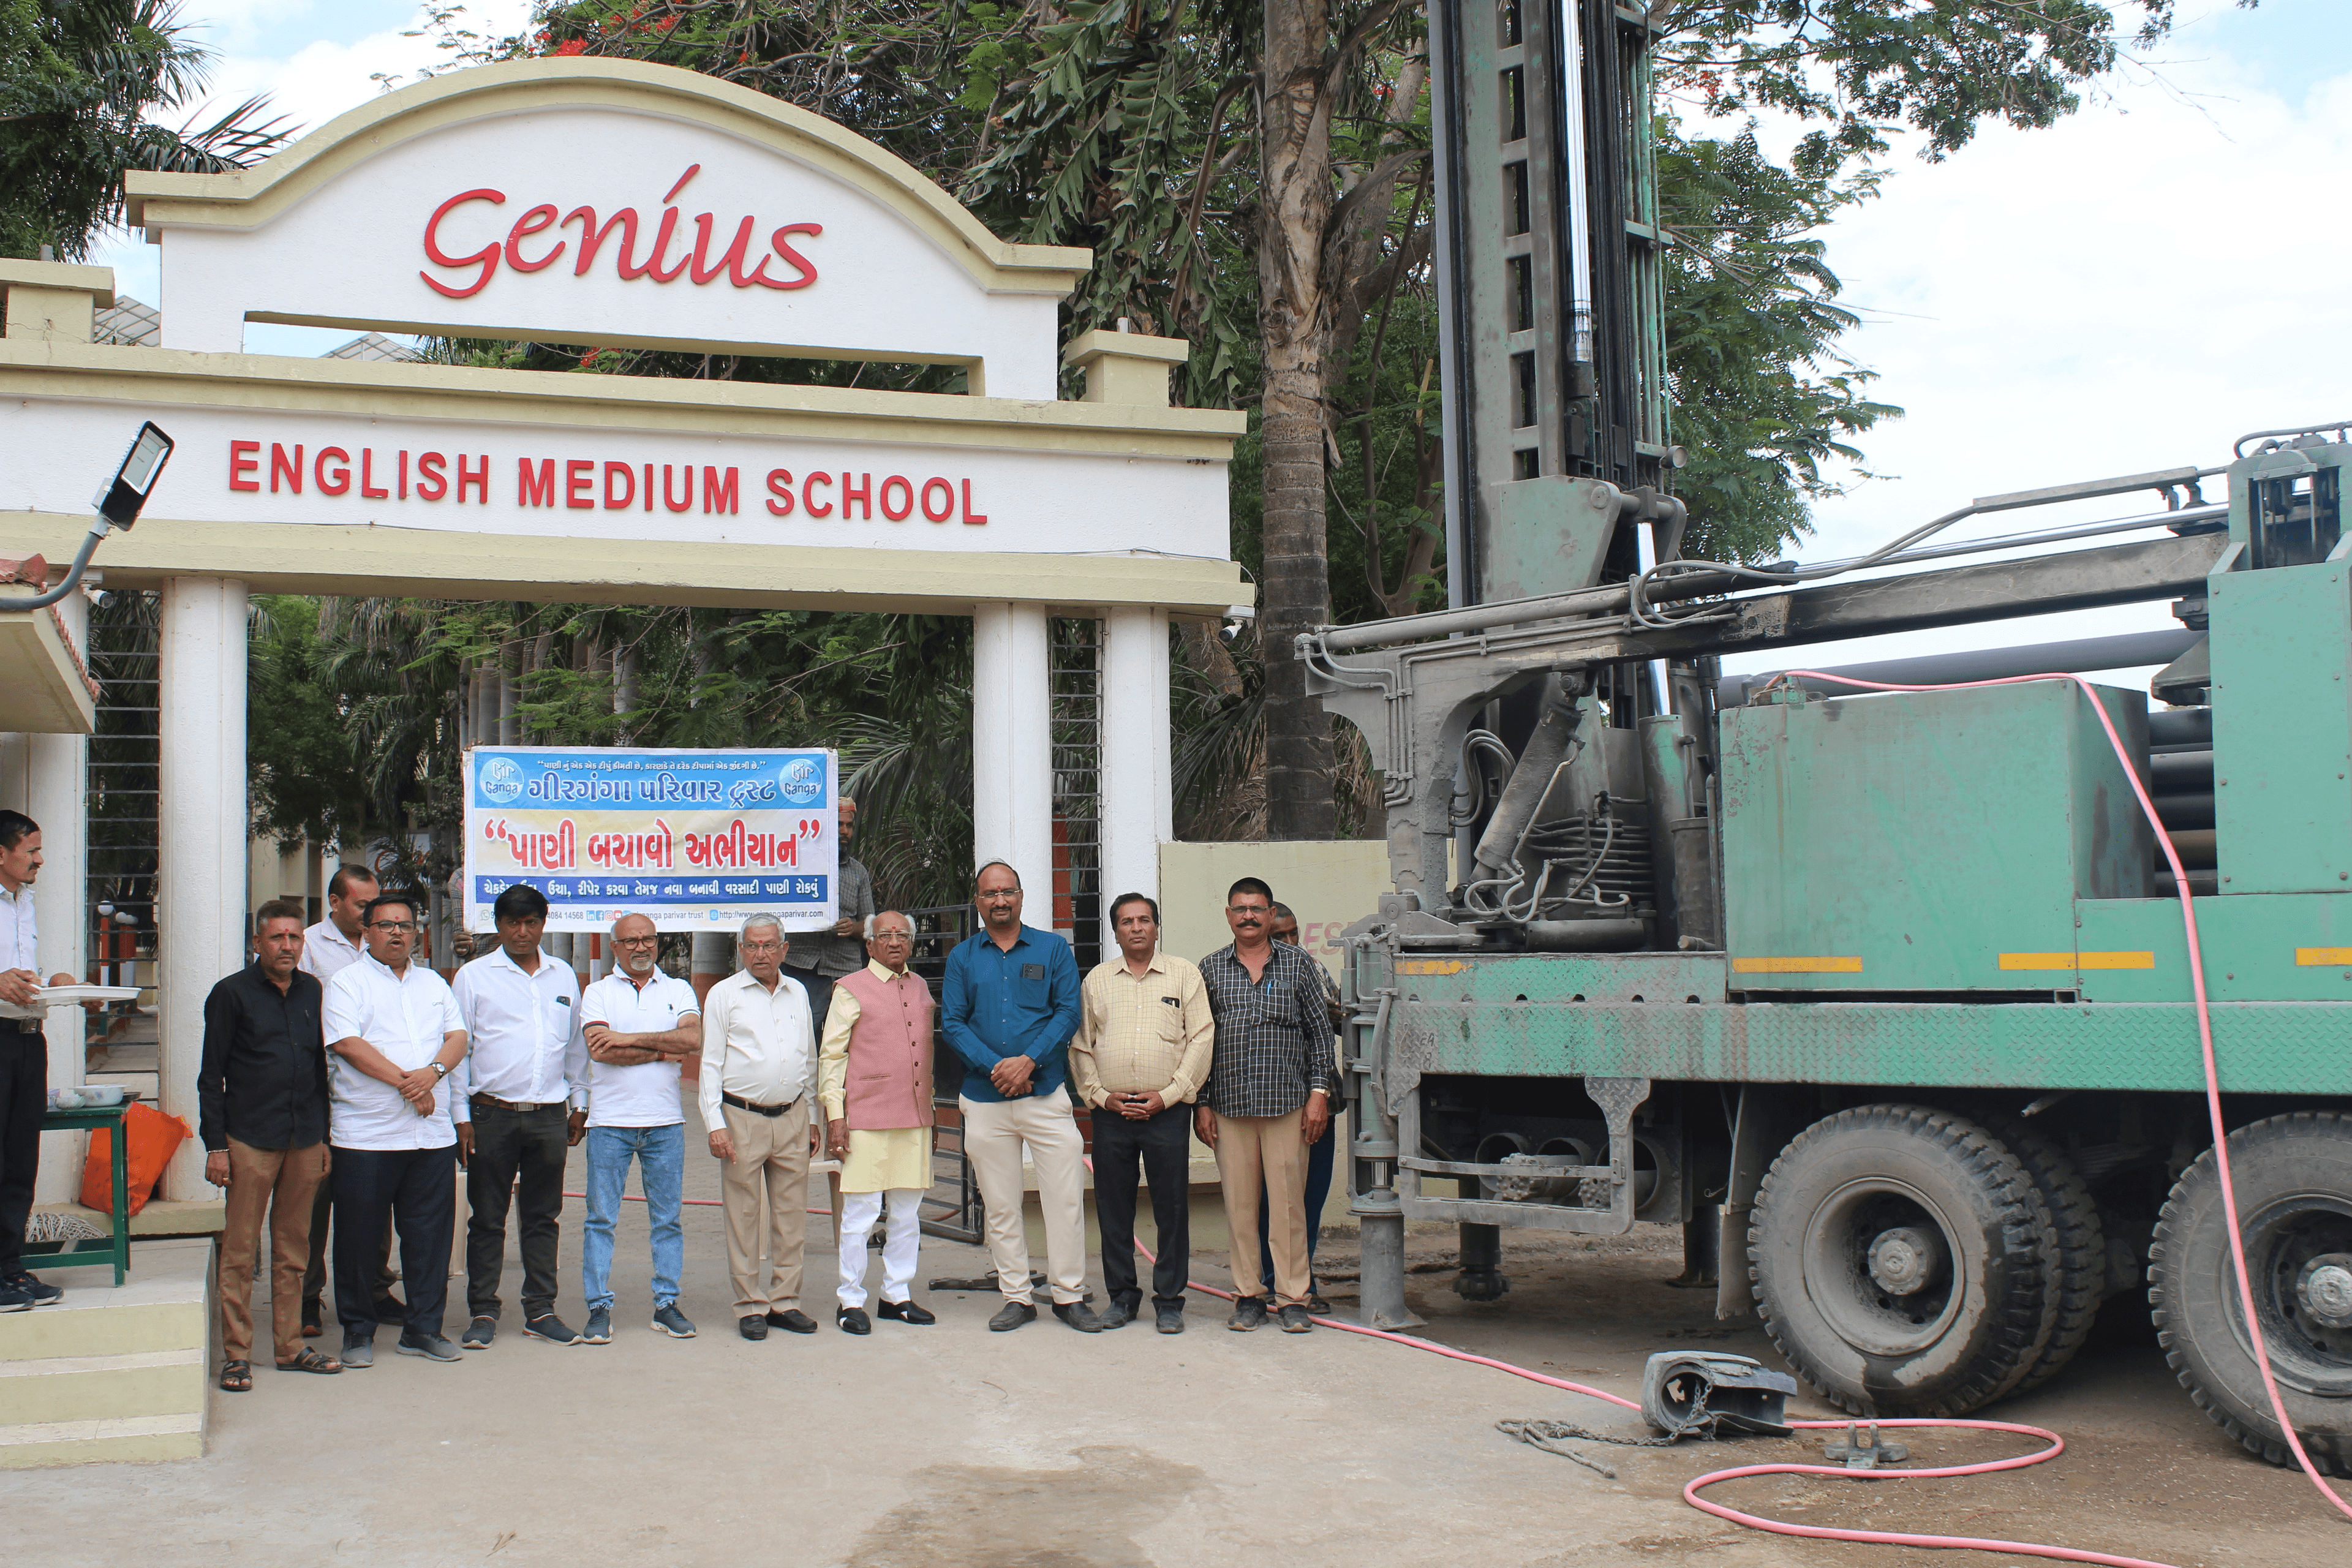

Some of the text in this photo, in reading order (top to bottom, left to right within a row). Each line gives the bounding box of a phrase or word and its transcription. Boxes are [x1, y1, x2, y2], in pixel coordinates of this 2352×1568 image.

[420, 164, 823, 298] Genius
[230, 440, 987, 524] ENGLISH MEDIUM SCHOOL
[492, 761, 515, 781] Gir
[571, 761, 583, 769] એક
[584, 761, 597, 769] એક
[677, 761, 690, 770] દરેક
[716, 761, 728, 770] એક
[791, 763, 815, 782] Gir
[486, 781, 518, 795] Ganga
[528, 771, 776, 809] ગીરગંગા પરિવાર ટ્રસ્ટ
[785, 783, 816, 796] Ganga
[587, 817, 673, 870] બચાવો
[577, 880, 600, 895] રીપેર
[606, 884, 628, 895] કરવા
[635, 880, 658, 895] તેમજ
[663, 884, 683, 895] નવા
[688, 879, 719, 895] બનાવી
[725, 878, 759, 895] વરસાદી
[765, 878, 790, 894] પાણી
[796, 878, 820, 899] રોકવું
[565, 911, 584, 919] 14568
[664, 910, 687, 920] parivar
[688, 910, 704, 919] trust
[1297, 921, 1357, 956] ES
